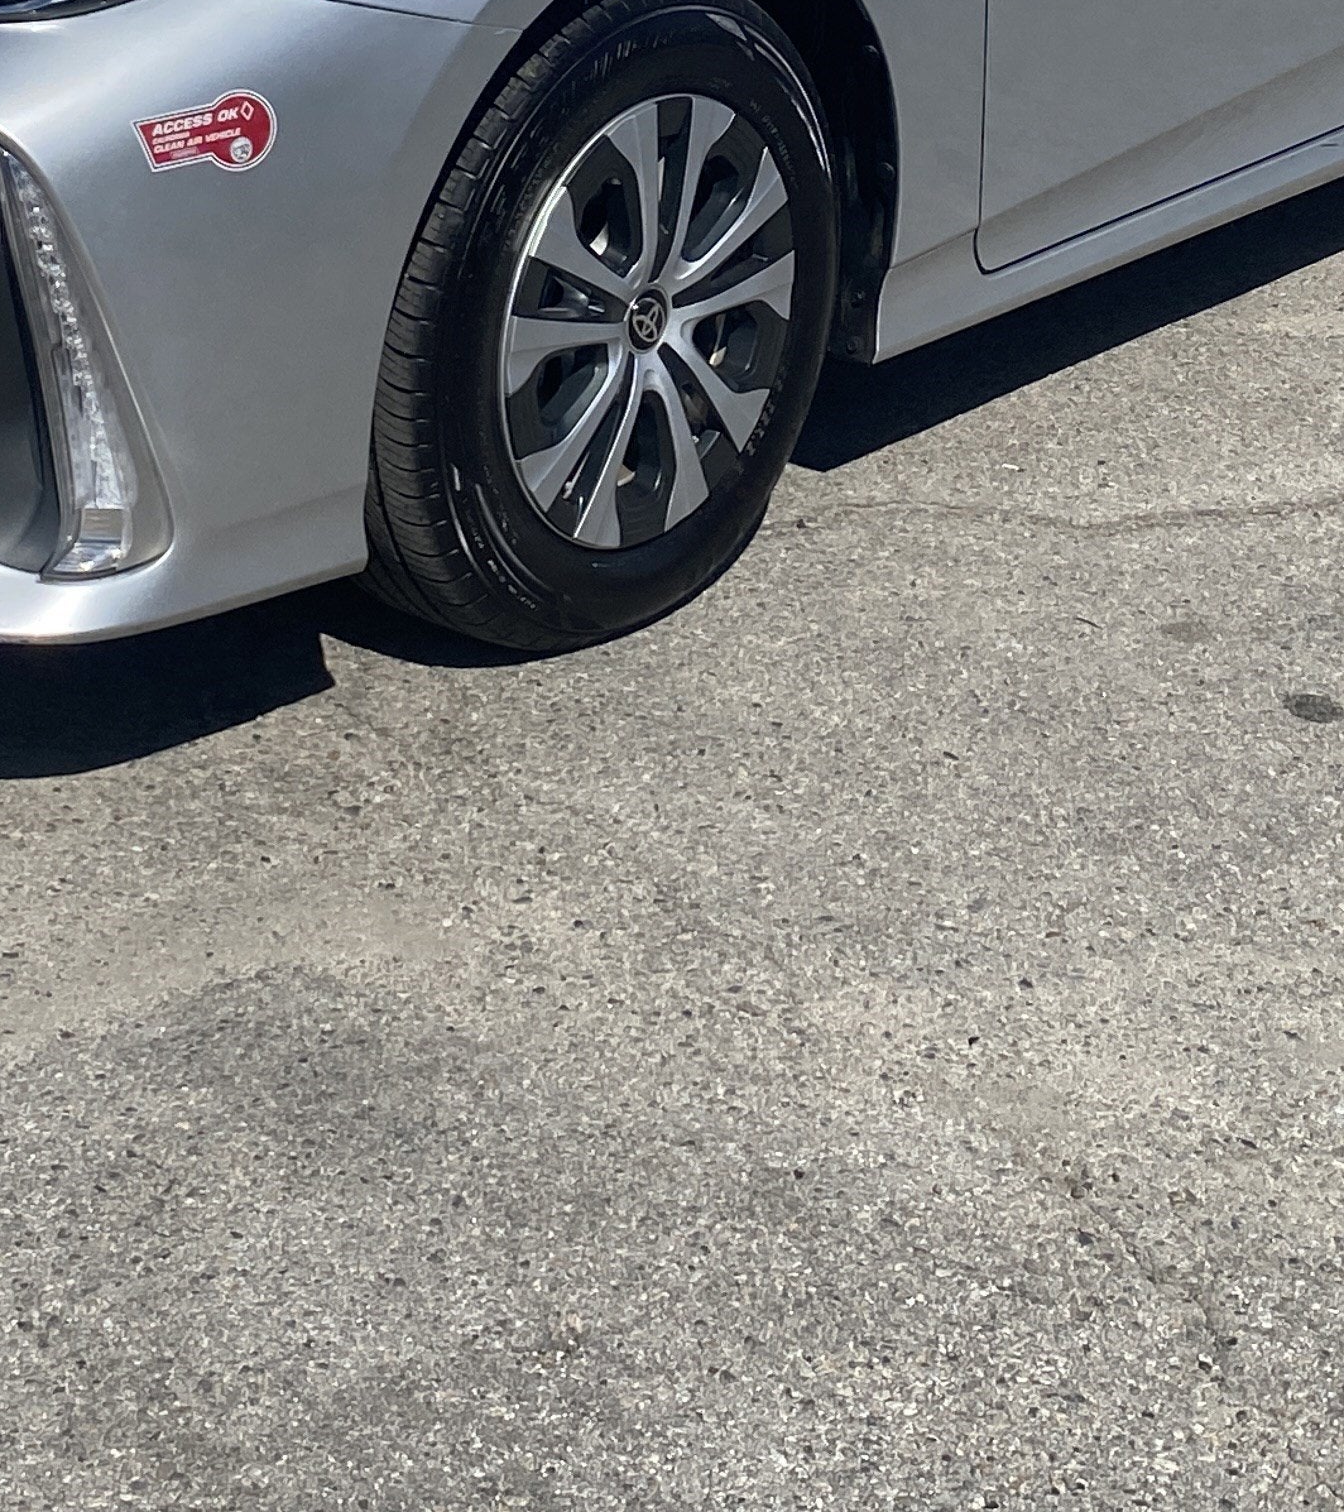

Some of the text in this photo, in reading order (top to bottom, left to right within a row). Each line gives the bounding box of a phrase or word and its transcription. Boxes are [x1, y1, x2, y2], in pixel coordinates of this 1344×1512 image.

[151, 106, 241, 137] ACCESS OK
[153, 139, 185, 154] CLEAN
[186, 136, 203, 148] AIR
[205, 127, 241, 143] VEHICLE
